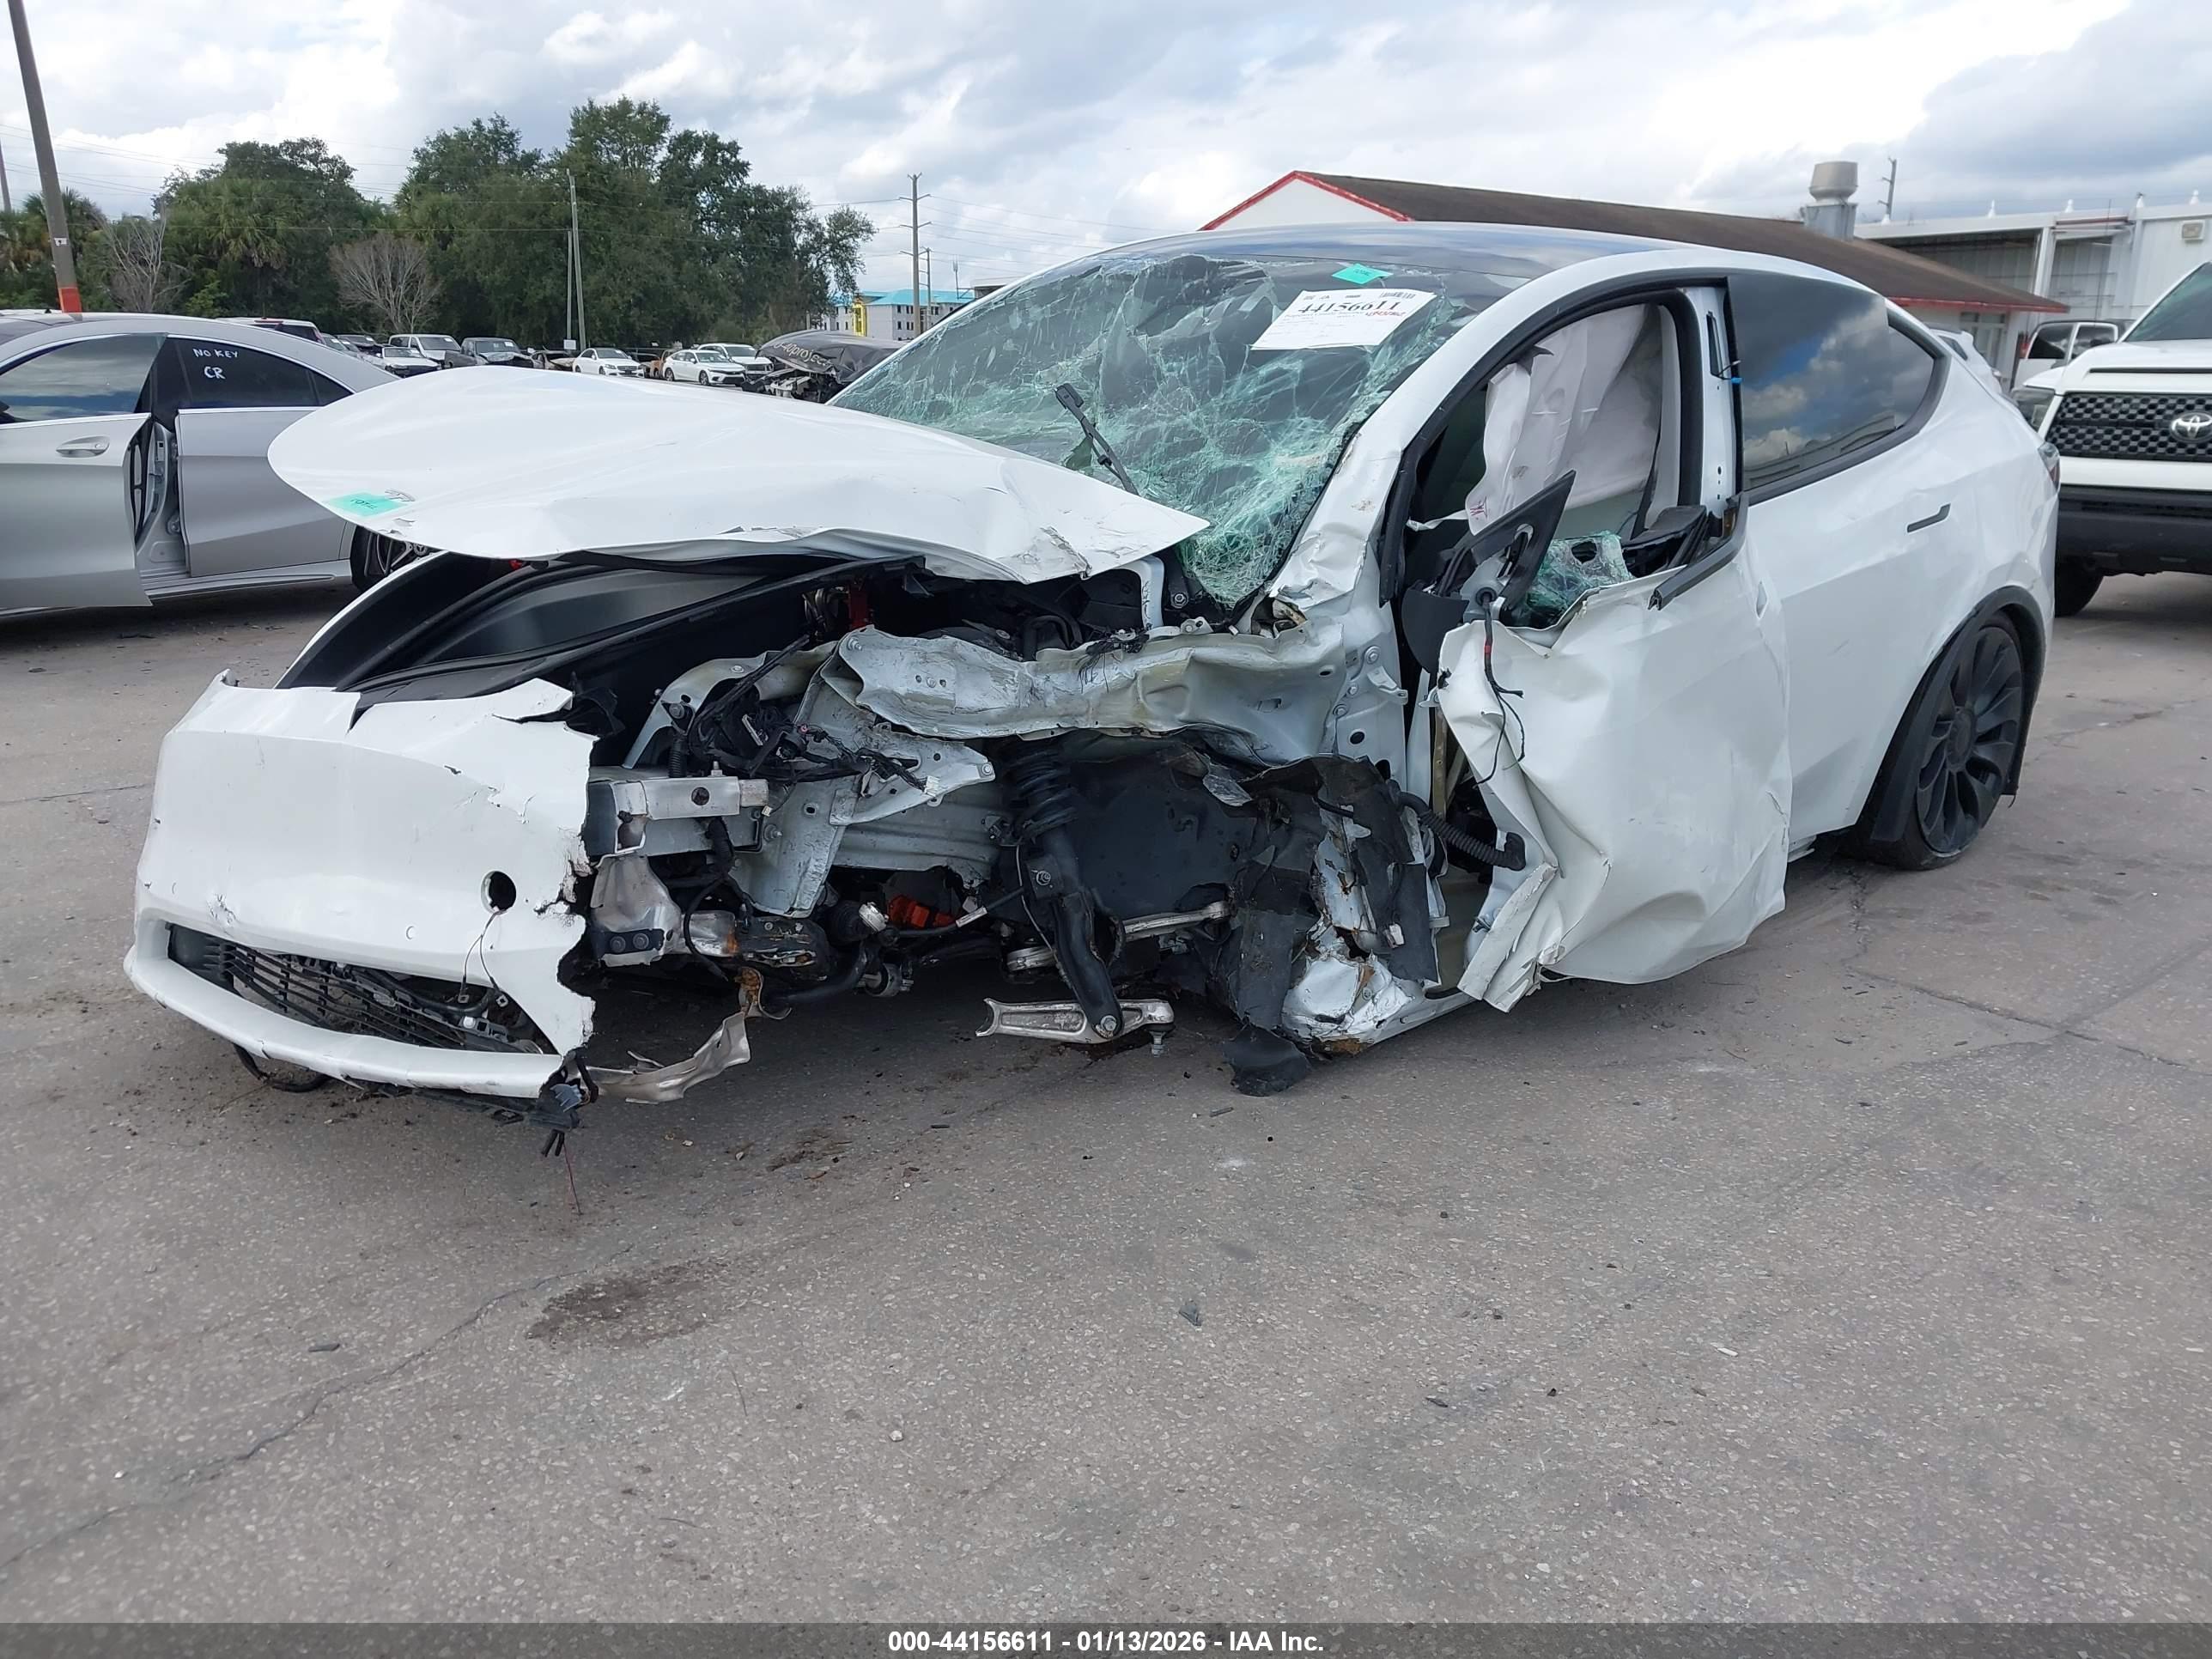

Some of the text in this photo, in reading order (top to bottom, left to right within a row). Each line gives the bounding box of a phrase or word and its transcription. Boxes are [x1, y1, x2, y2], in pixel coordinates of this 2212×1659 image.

[192, 348, 238, 358] NO KEY
[204, 366, 226, 380] CR
